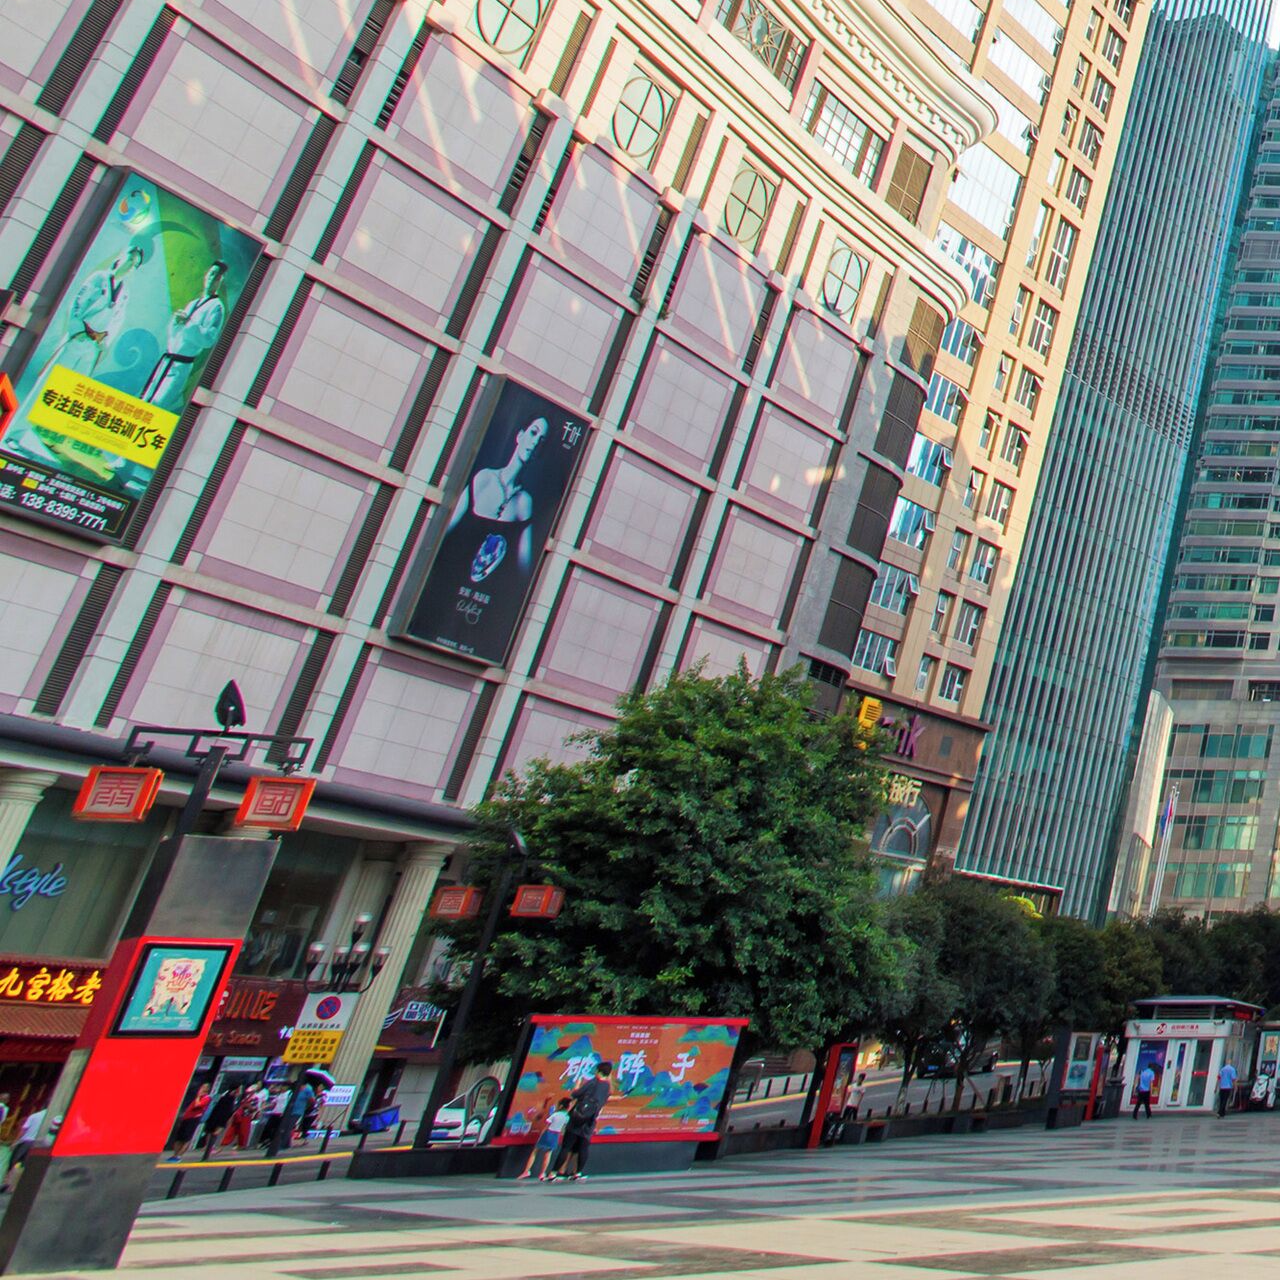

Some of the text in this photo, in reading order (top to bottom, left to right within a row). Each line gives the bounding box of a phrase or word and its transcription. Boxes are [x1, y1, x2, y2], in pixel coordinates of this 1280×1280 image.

[42, 389, 167, 450] 专注跆拳道培训15年
[20, 491, 109, 531] 138-8399-7771
